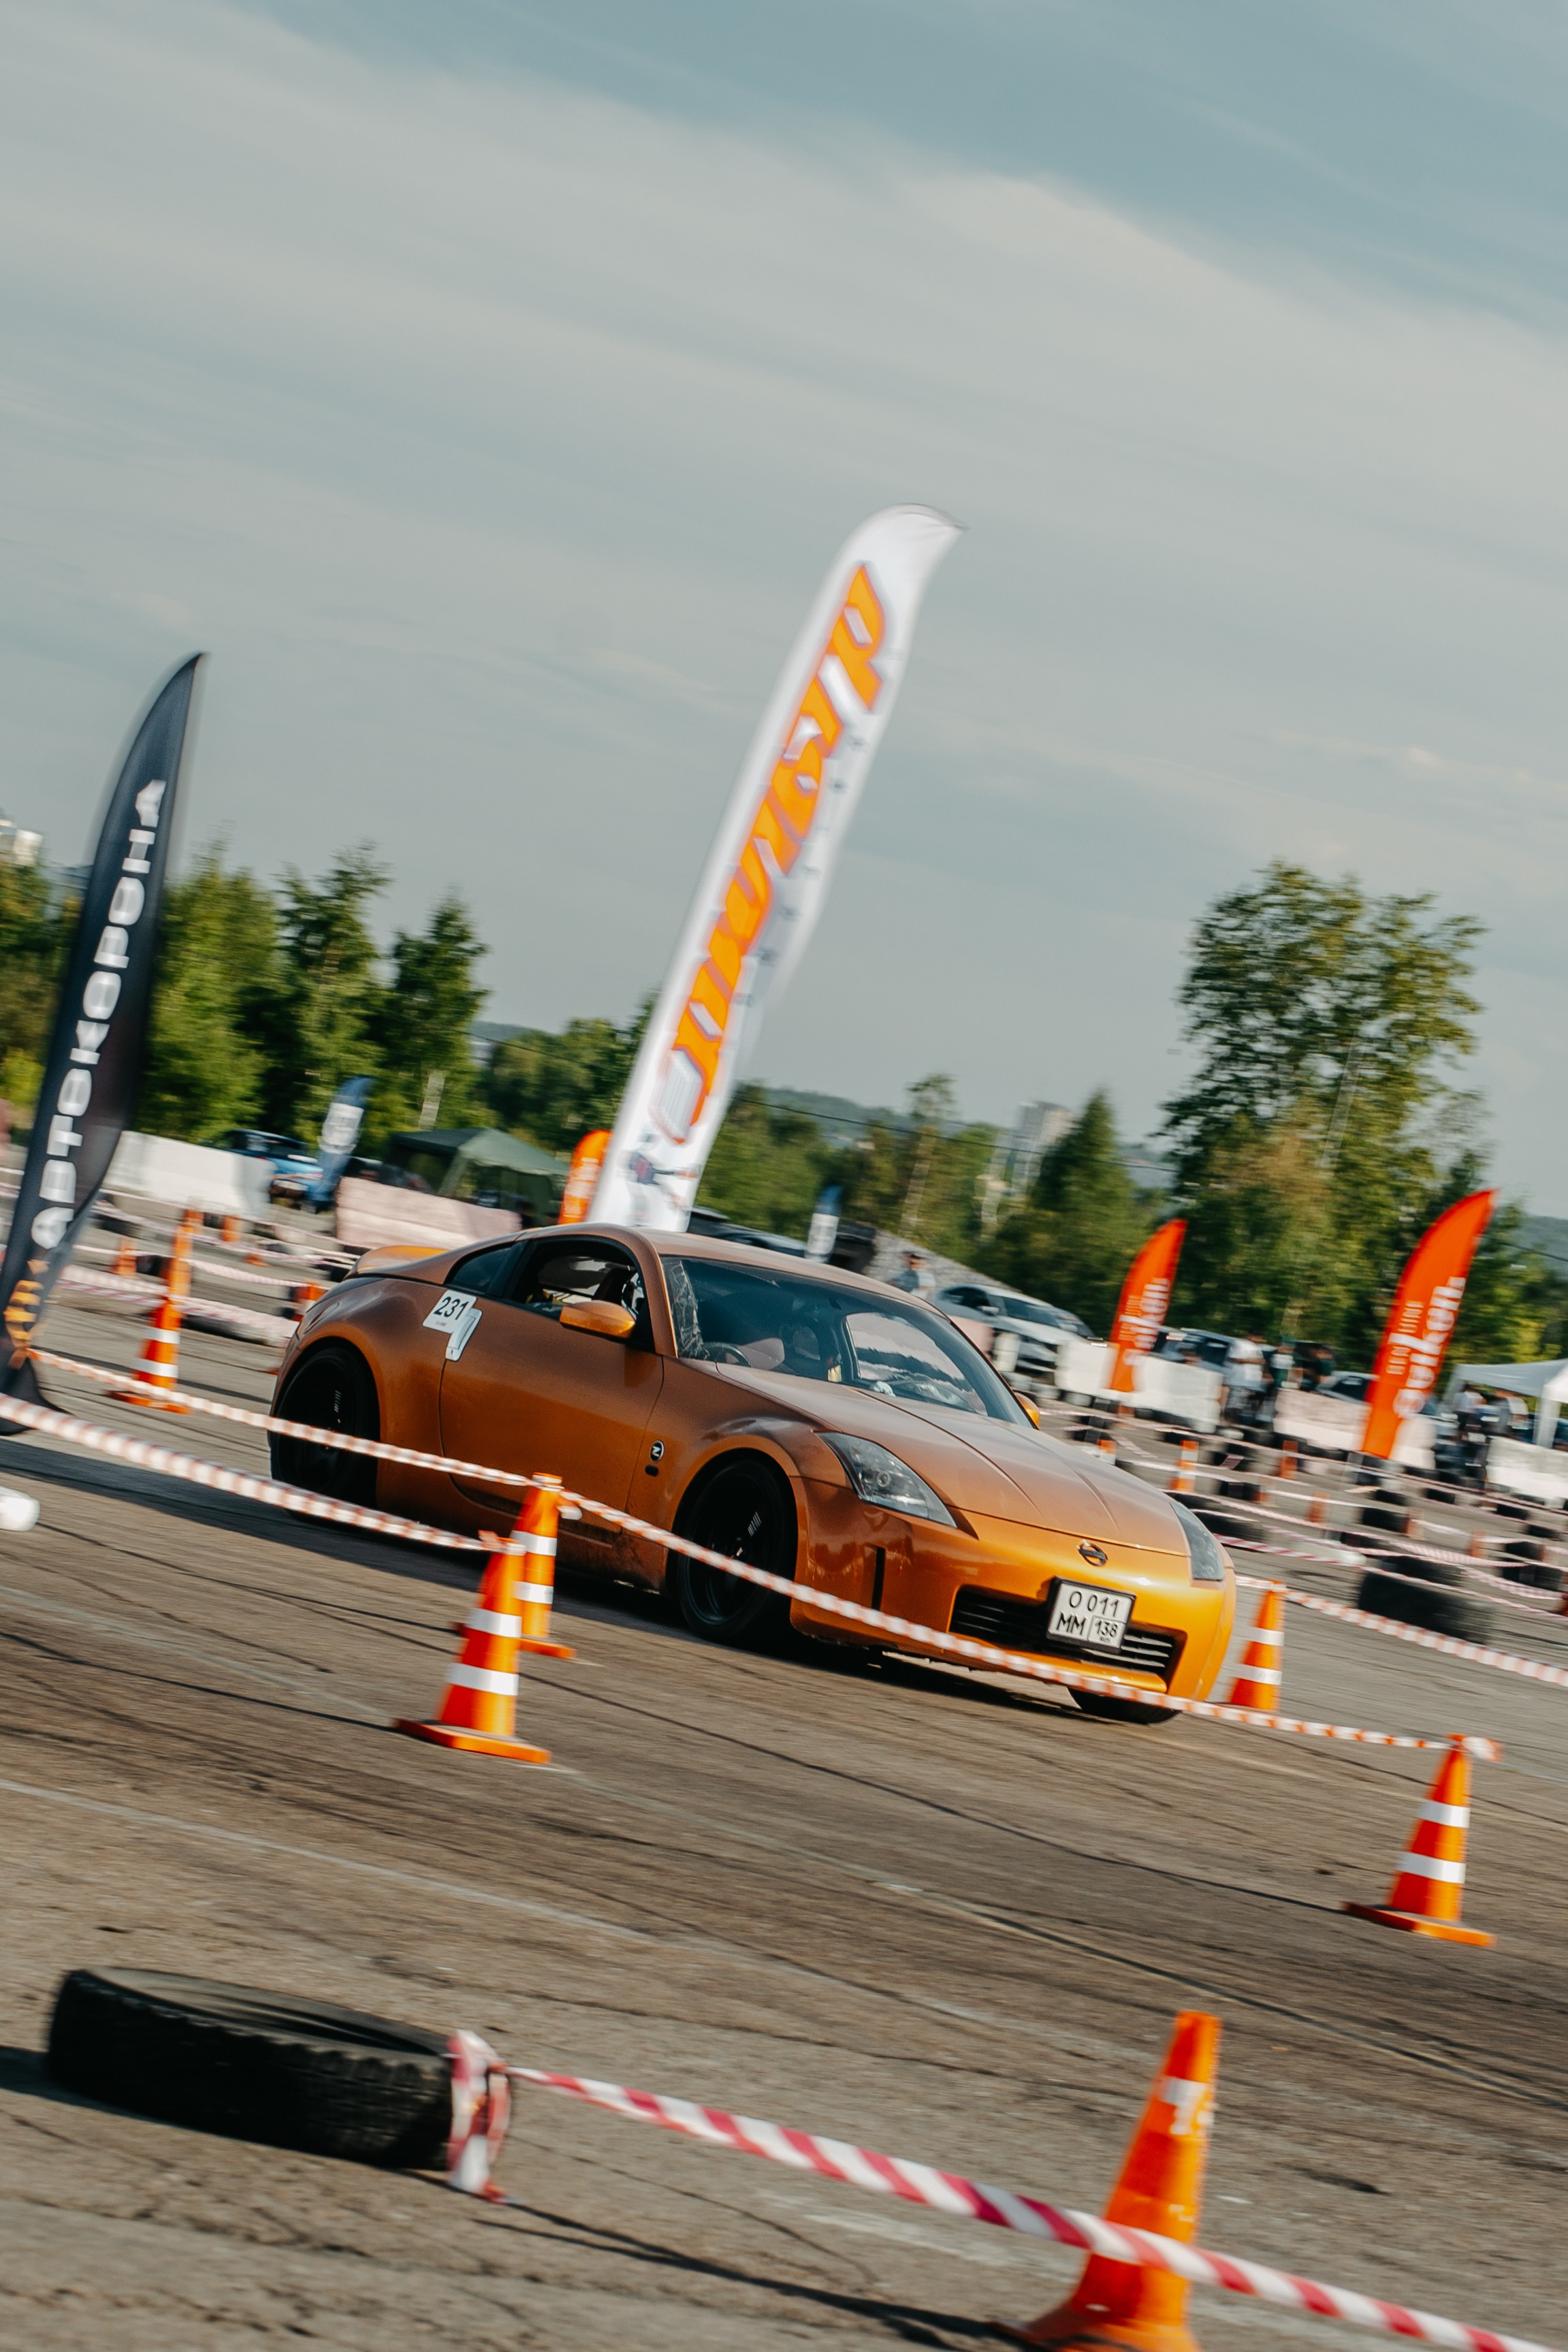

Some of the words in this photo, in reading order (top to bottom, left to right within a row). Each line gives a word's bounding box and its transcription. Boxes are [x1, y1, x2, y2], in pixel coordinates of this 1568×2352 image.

[31, 780, 166, 1250] АВТОКОРОНА
[434, 1297, 469, 1320] 231
[1087, 1594, 1120, 1617] 011
[1056, 1612, 1087, 1636] MM
[1095, 1620, 1118, 1637] 138
